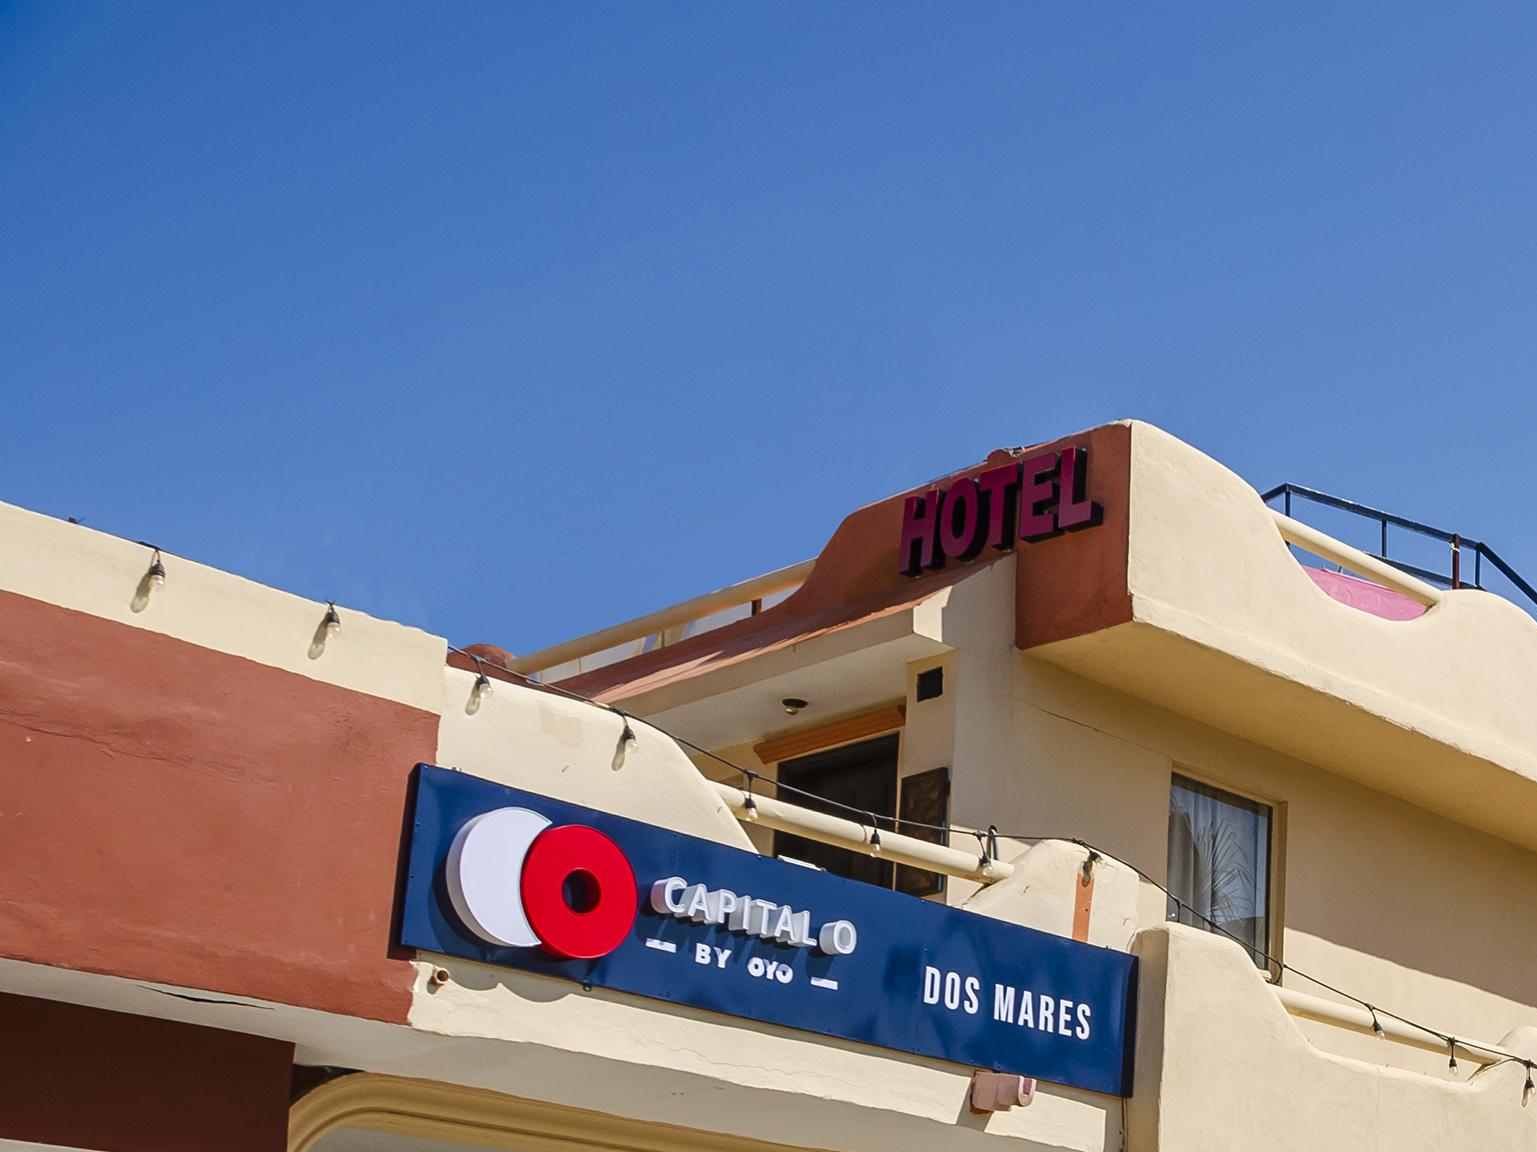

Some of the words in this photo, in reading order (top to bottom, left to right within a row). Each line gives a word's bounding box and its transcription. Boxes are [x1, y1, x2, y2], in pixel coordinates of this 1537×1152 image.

[898, 446, 1104, 577] HOTEL
[651, 876, 817, 947] CAPITAL
[819, 919, 857, 955] O
[694, 943, 732, 968] BY
[747, 957, 793, 984] OYO
[923, 965, 980, 1015] DOS
[993, 983, 1091, 1040] MARES
